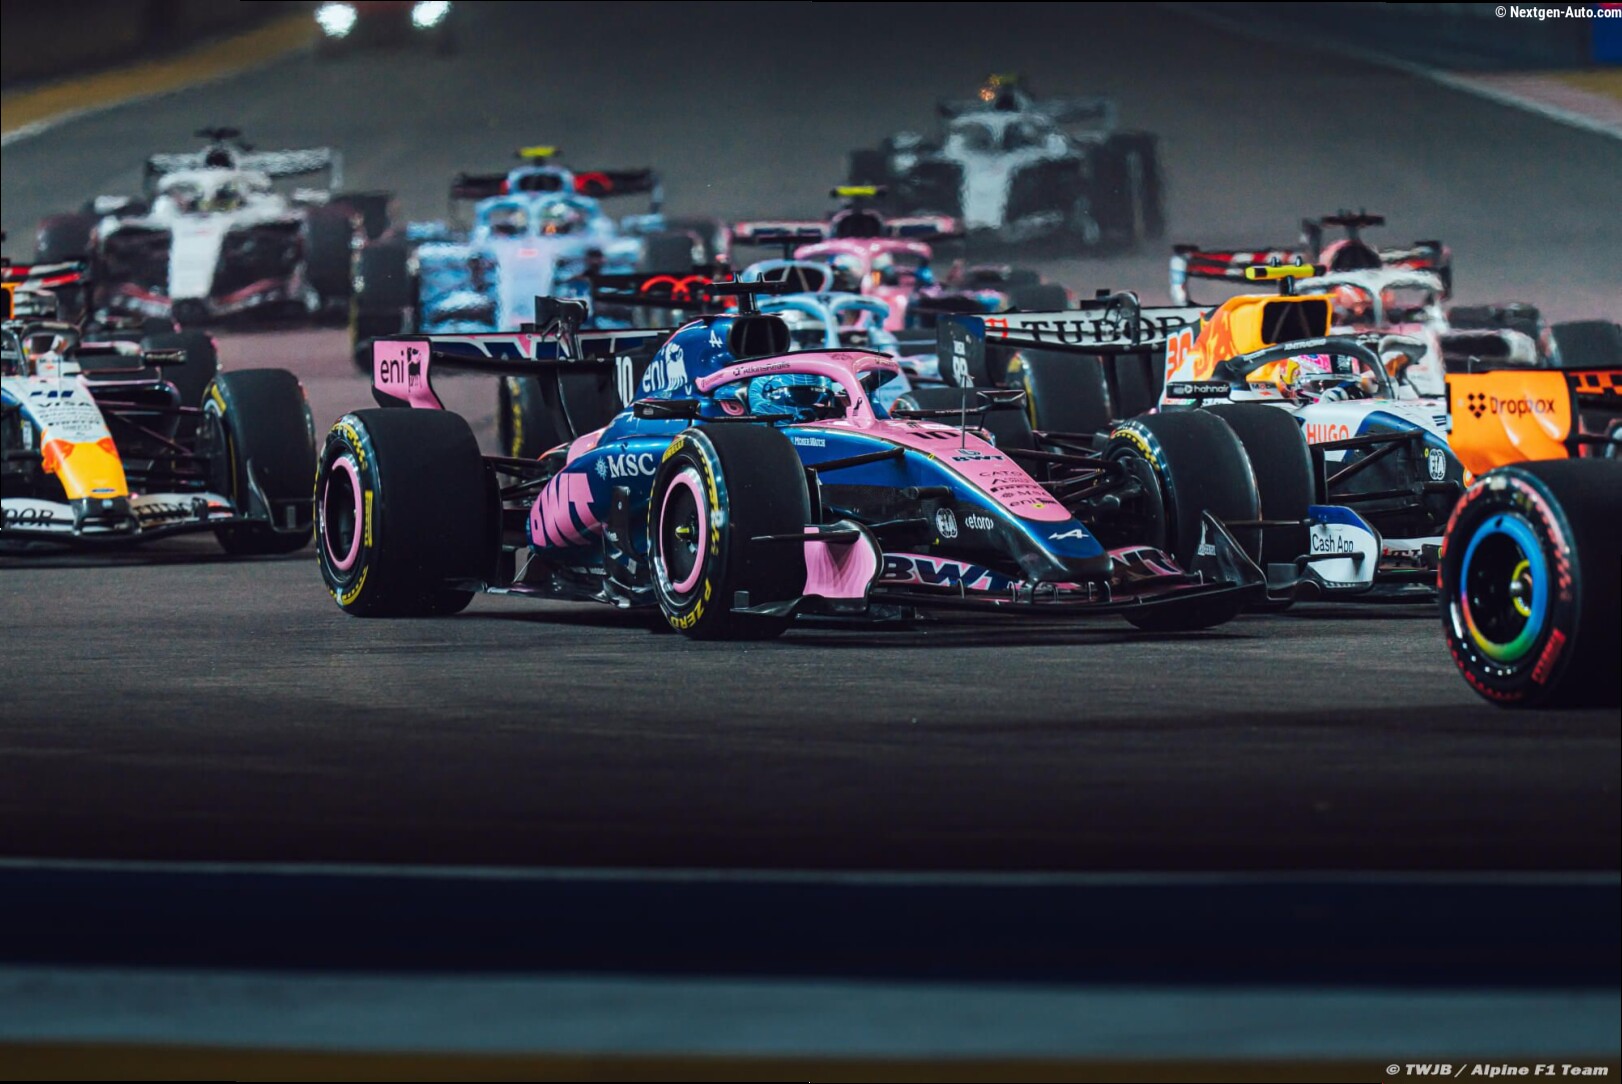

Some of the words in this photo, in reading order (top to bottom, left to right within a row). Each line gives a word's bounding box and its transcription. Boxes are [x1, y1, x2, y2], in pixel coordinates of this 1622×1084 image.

[381, 350, 404, 384] eni
[642, 348, 665, 393] eni
[616, 356, 634, 408] 10
[1194, 385, 1229, 393] hahnair
[1490, 396, 1555, 418] Dropbox
[1306, 424, 1350, 444] HUGO
[607, 453, 656, 479] MSC
[1010, 498, 1036, 507] eni
[1312, 533, 1335, 552] Cash
[670, 599, 705, 629] ZERO
